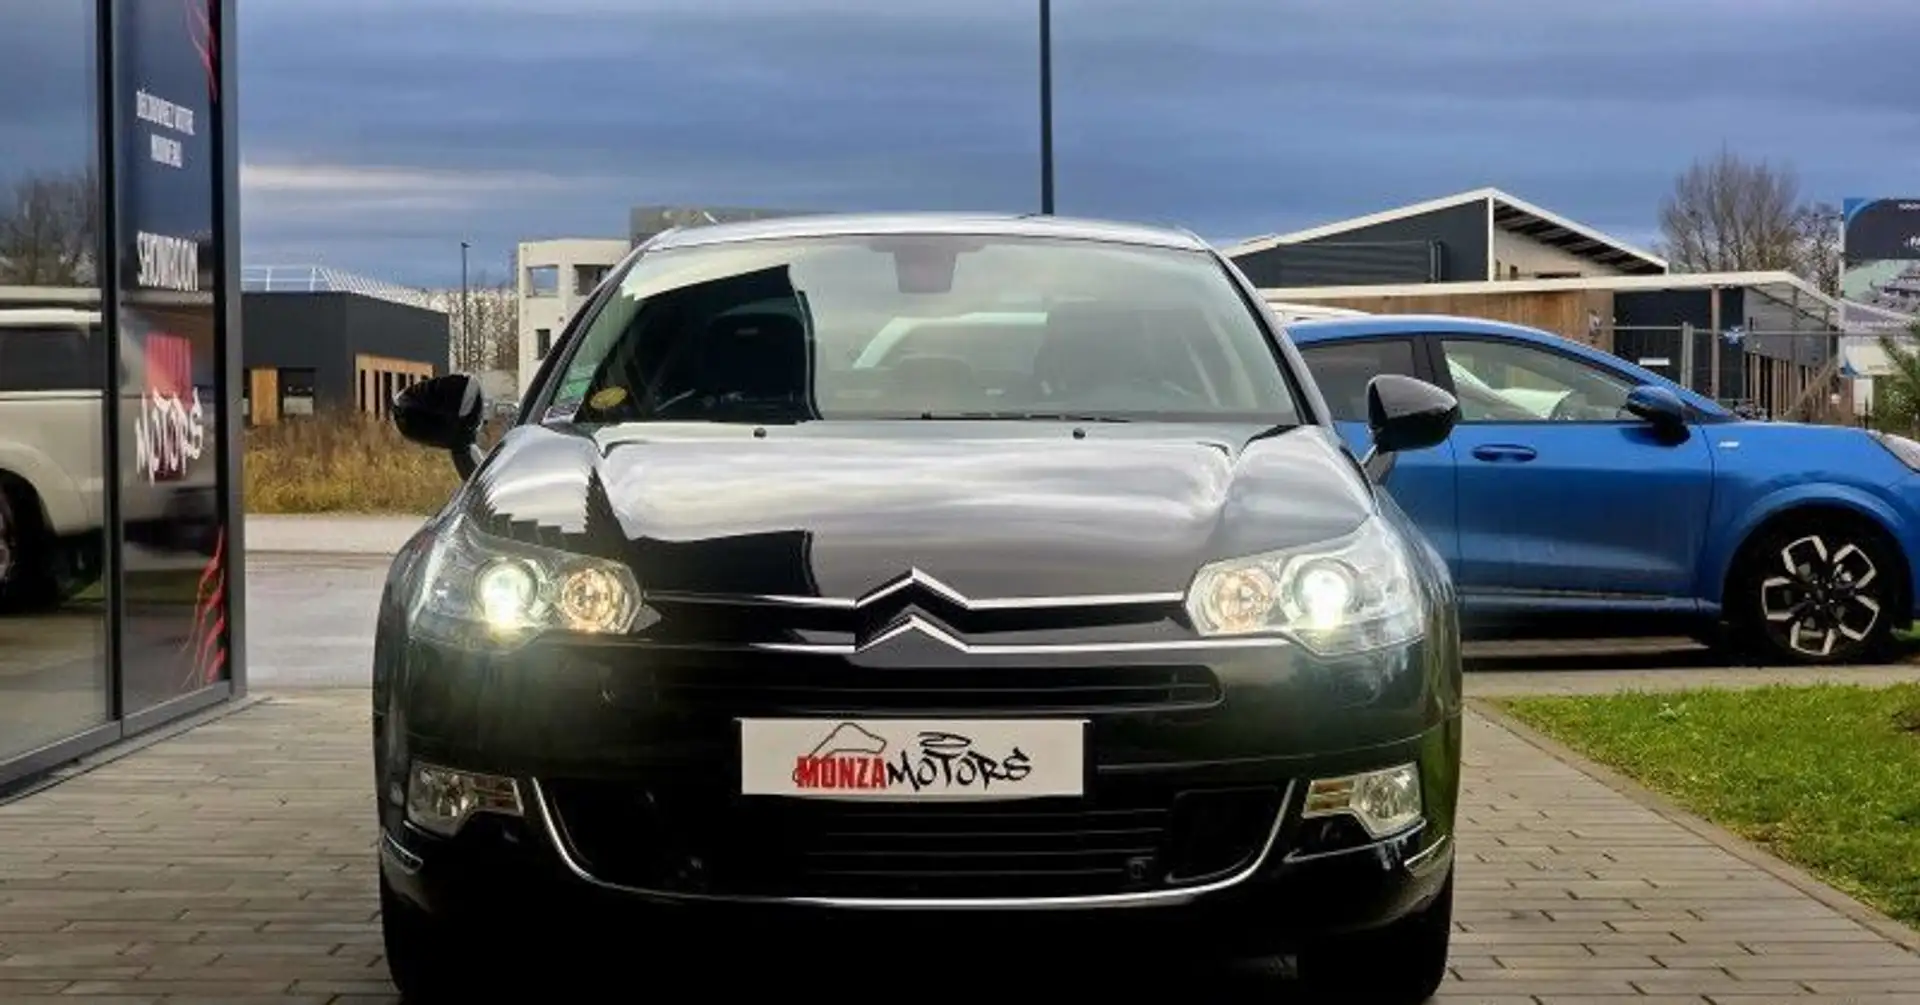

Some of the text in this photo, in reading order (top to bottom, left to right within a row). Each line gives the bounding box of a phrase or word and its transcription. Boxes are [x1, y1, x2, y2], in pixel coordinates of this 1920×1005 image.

[136, 230, 199, 292] SHOWROOM
[796, 747, 1032, 792] MONZA MOTORS
